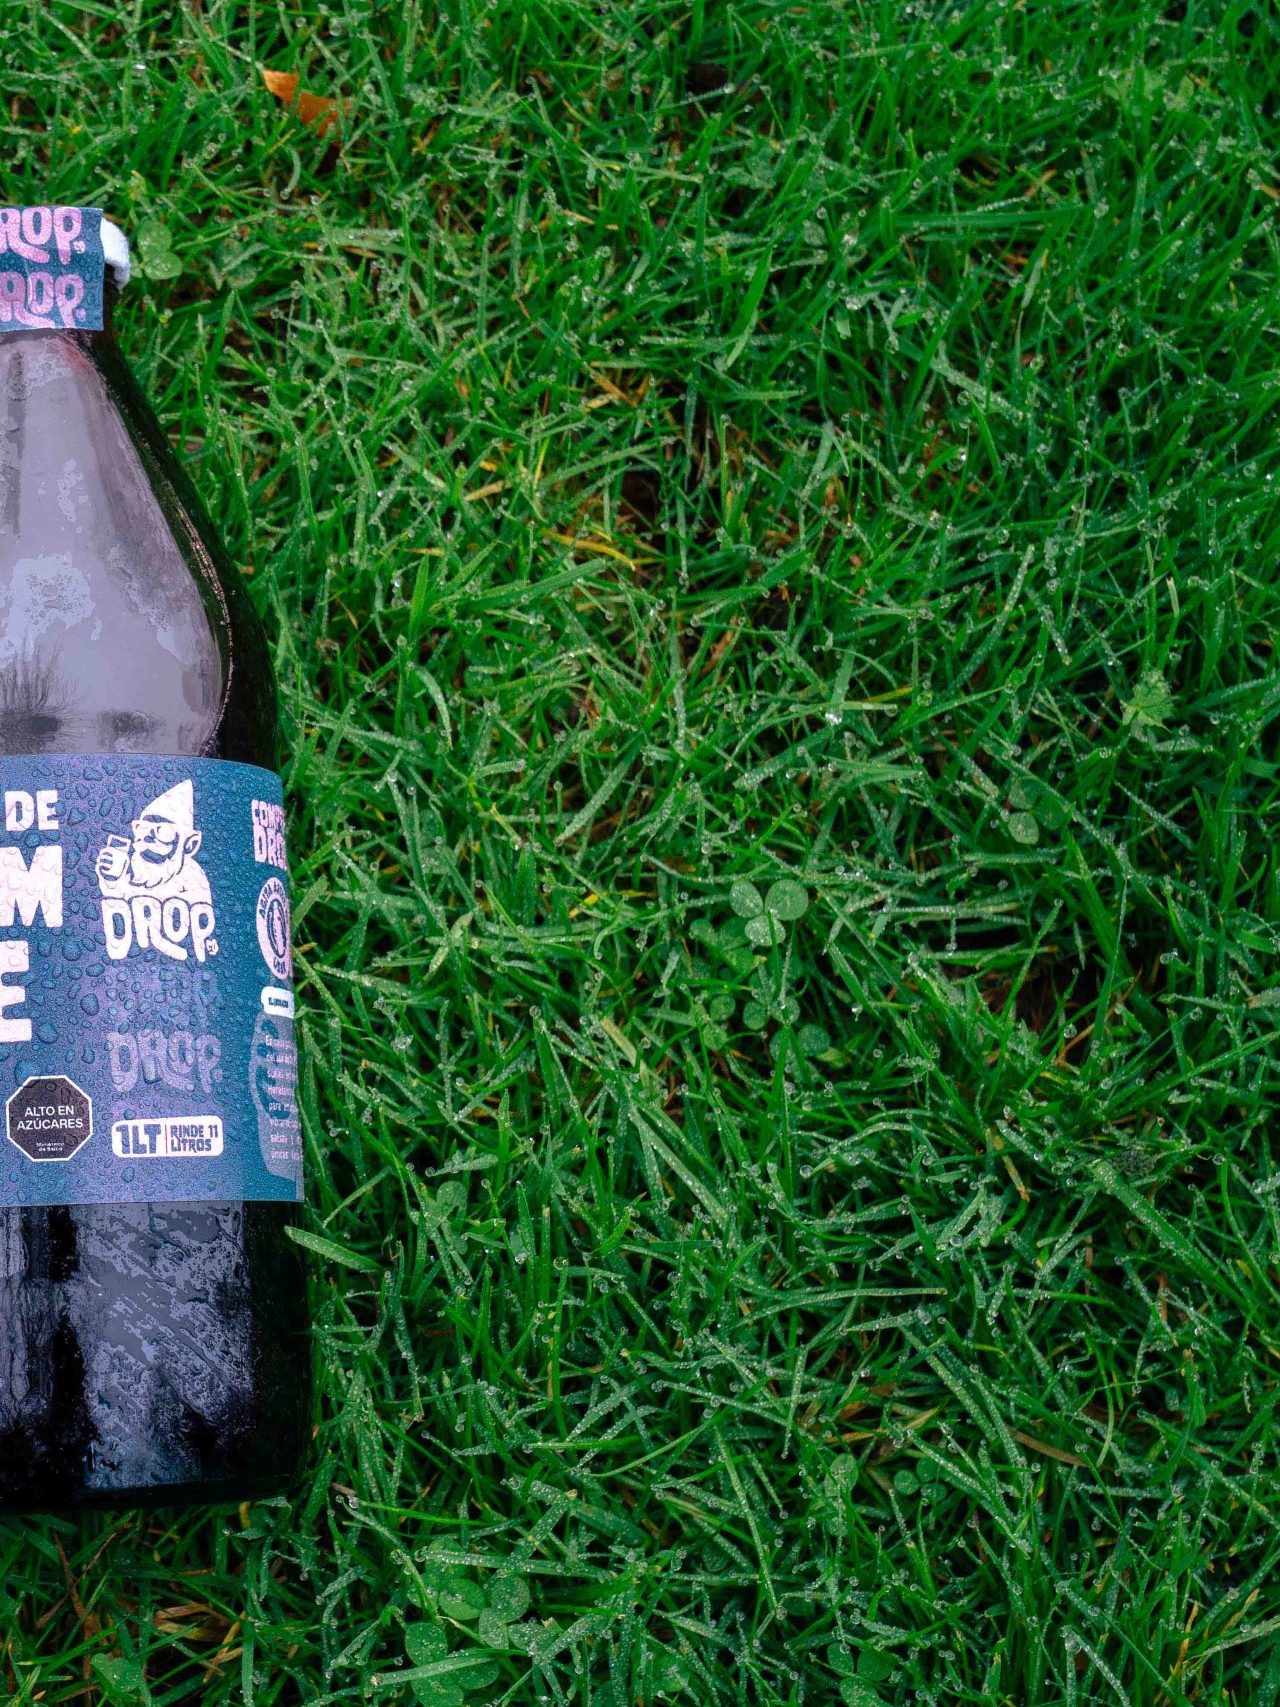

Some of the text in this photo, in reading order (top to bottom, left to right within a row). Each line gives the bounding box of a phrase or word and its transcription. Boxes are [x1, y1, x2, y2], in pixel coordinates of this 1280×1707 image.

[4, 789, 60, 832] DE
[24, 1104, 75, 1118] ALTO EN
[16, 1117, 84, 1131] AZÚCARES
[169, 1124, 219, 1138] RINDE 11
[115, 1123, 162, 1155] 1LT
[170, 1138, 212, 1153] LITROS
